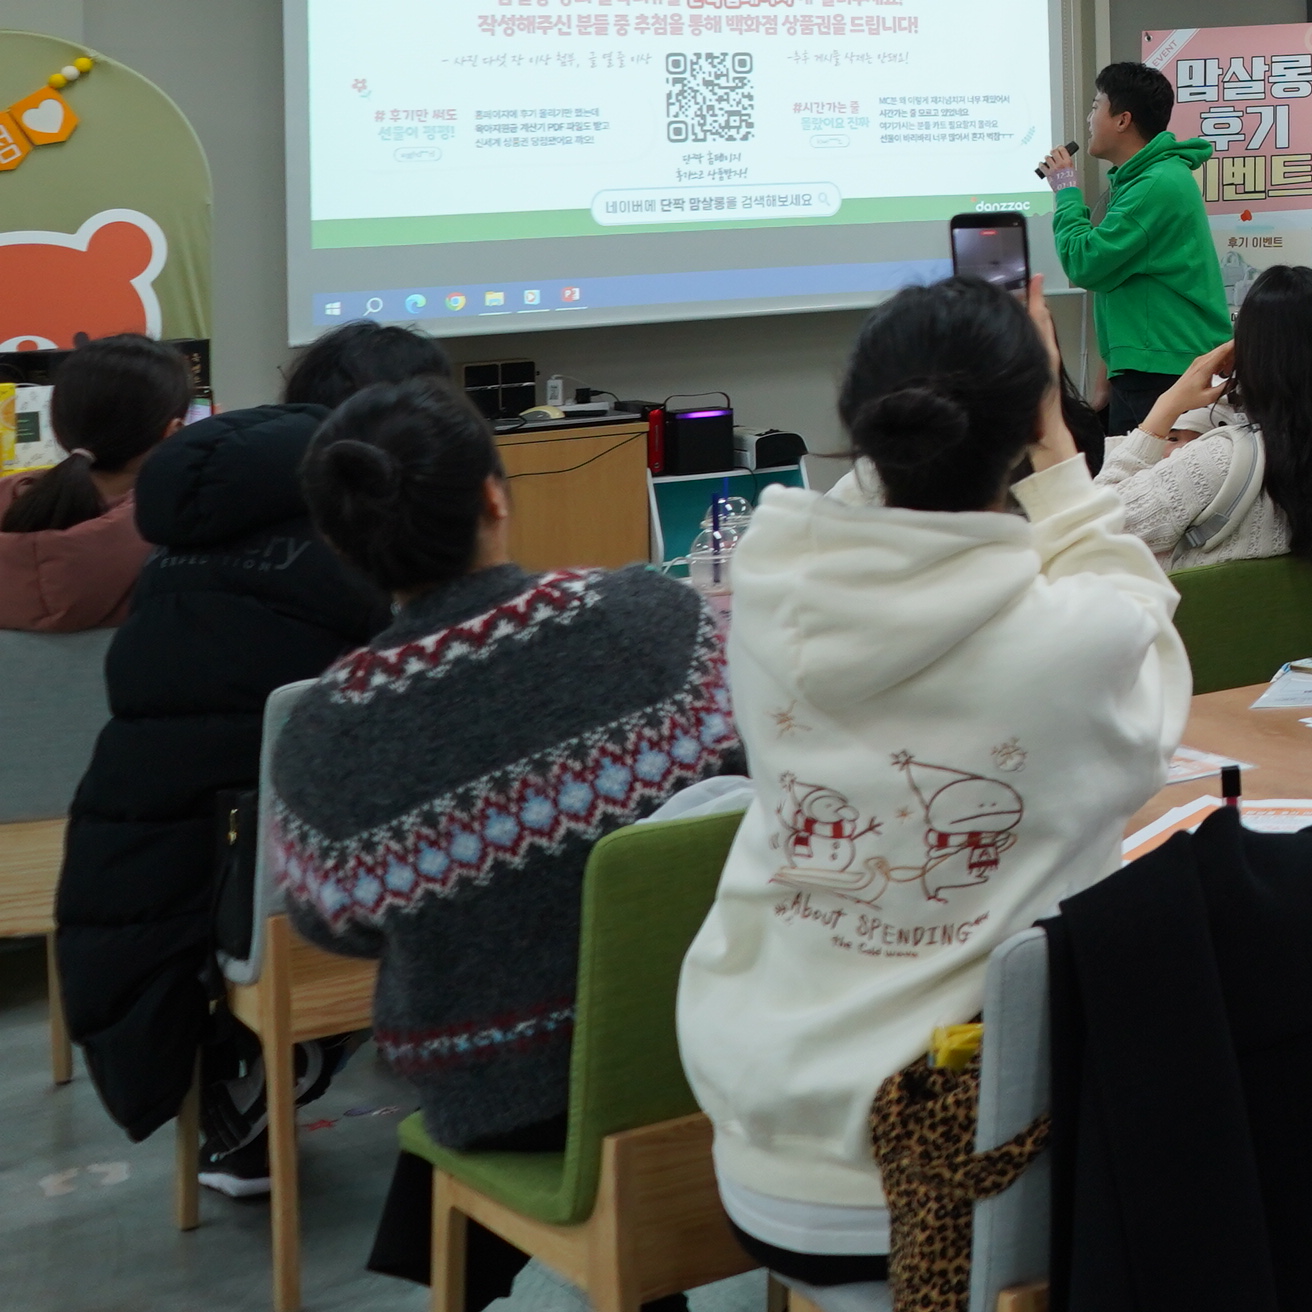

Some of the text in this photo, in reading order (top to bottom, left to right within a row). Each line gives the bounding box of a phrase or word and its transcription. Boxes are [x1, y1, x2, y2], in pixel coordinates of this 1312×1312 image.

[478, 14, 919, 37] 작성해주신 분들 중 추첨을 통해 백화점 상품권을 드립니다!
[1153, 40, 1177, 68] EVENT
[389, 108, 429, 122] 후기만
[547, 123, 565, 132] PDF
[1198, 104, 1290, 151] 후기
[605, 193, 813, 214] 네이버에 단짝 맘살롱을 검색해보세요
[975, 201, 1031, 212] danzzac
[1227, 236, 1283, 249] 후기 이벤트
[790, 891, 974, 946] About SPENDING
